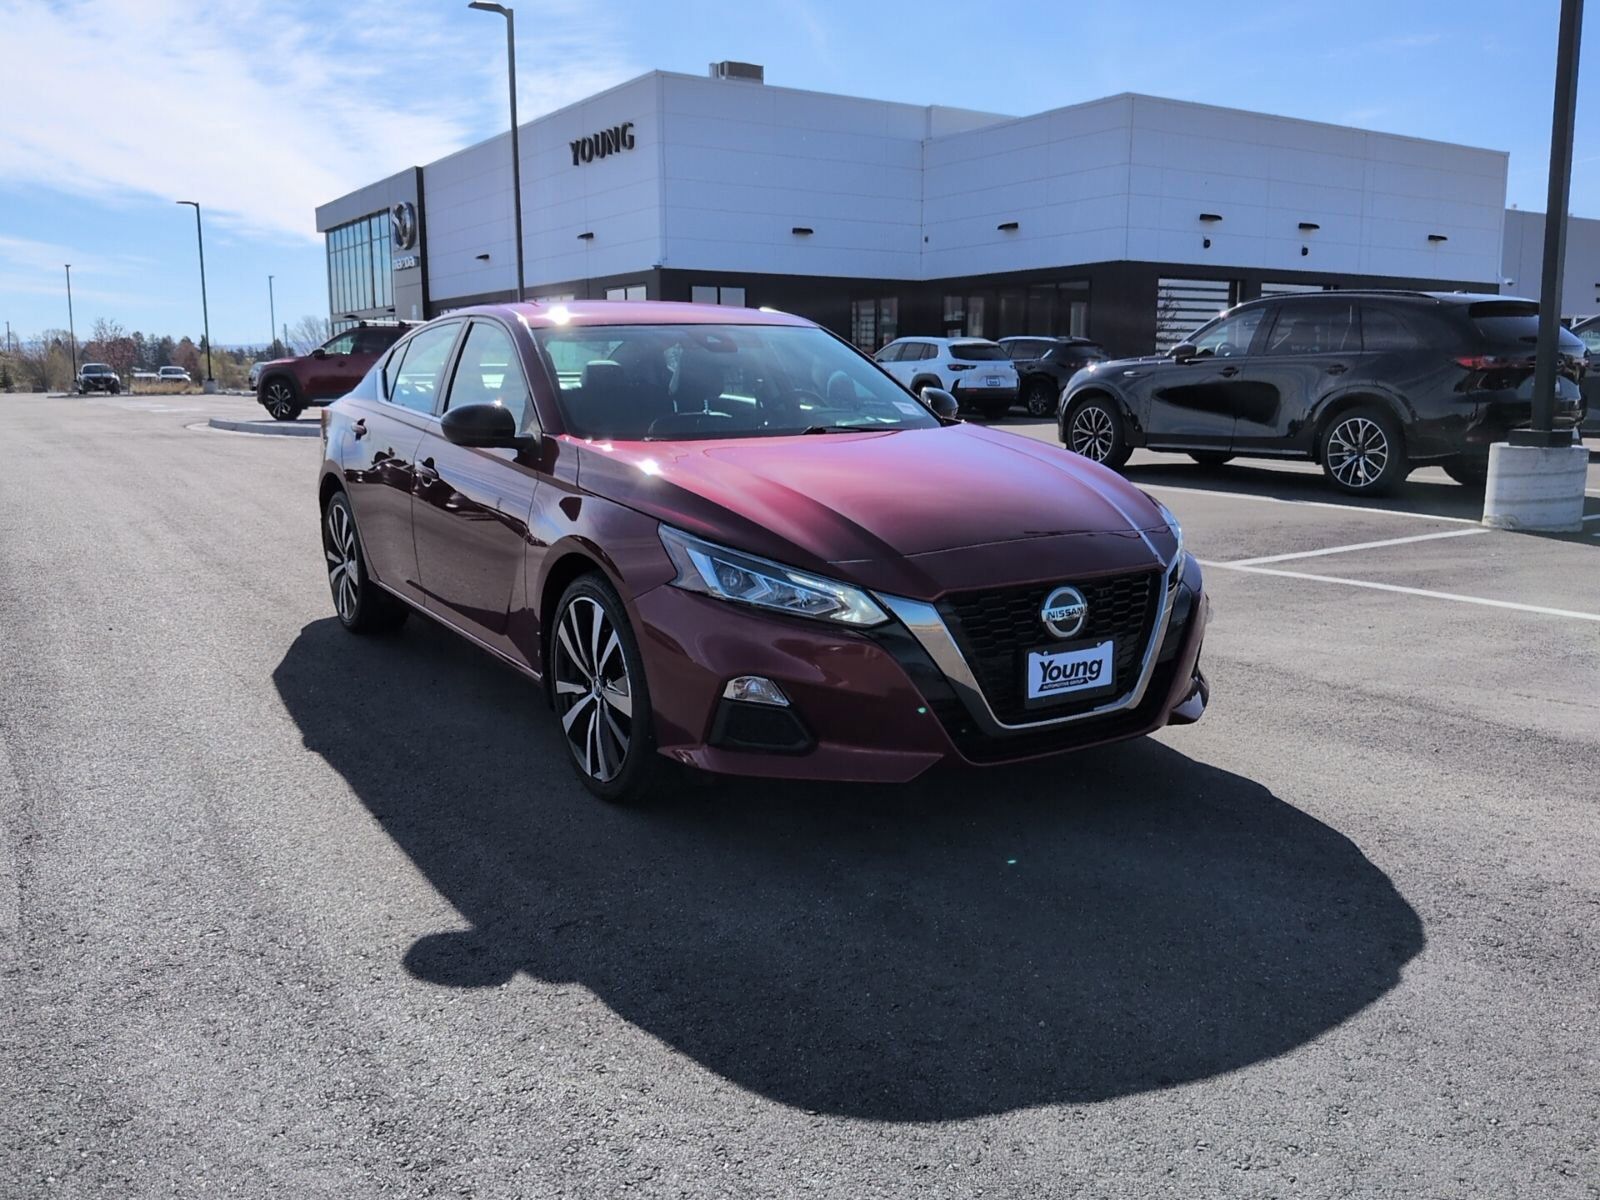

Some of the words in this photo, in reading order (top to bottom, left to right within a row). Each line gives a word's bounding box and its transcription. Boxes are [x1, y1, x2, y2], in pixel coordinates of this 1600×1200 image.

[569, 122, 634, 166] YOUNG
[1047, 606, 1084, 619] NISSAN
[1039, 659, 1103, 683] Young
